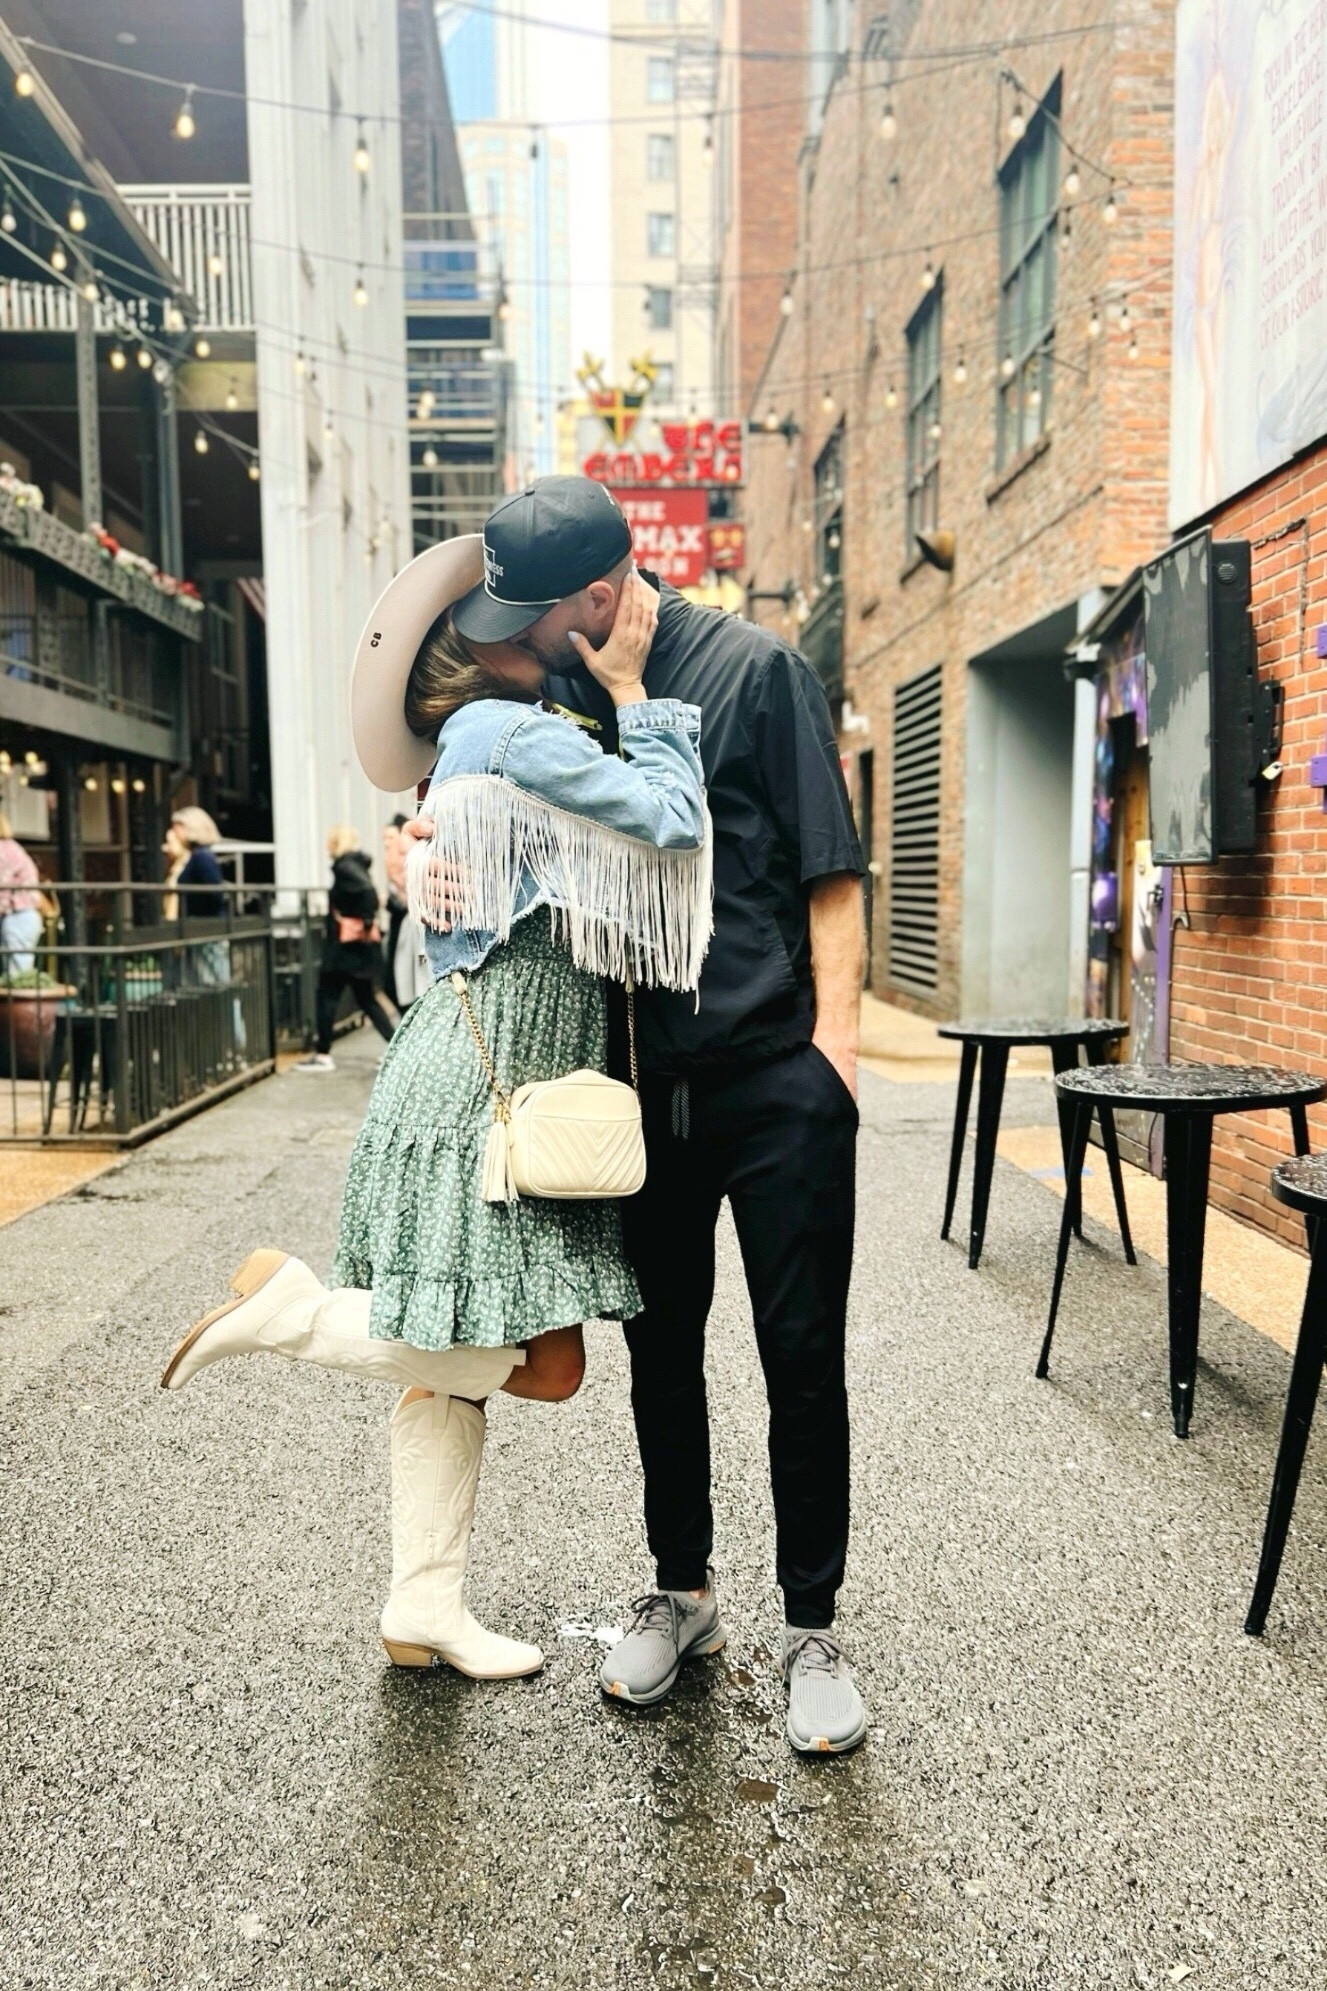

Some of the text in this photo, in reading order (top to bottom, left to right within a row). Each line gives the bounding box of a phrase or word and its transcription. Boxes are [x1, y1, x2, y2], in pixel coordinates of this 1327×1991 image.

[622, 500, 666, 522] THE
[632, 524, 704, 553] MAX
[370, 632, 382, 648] CB
